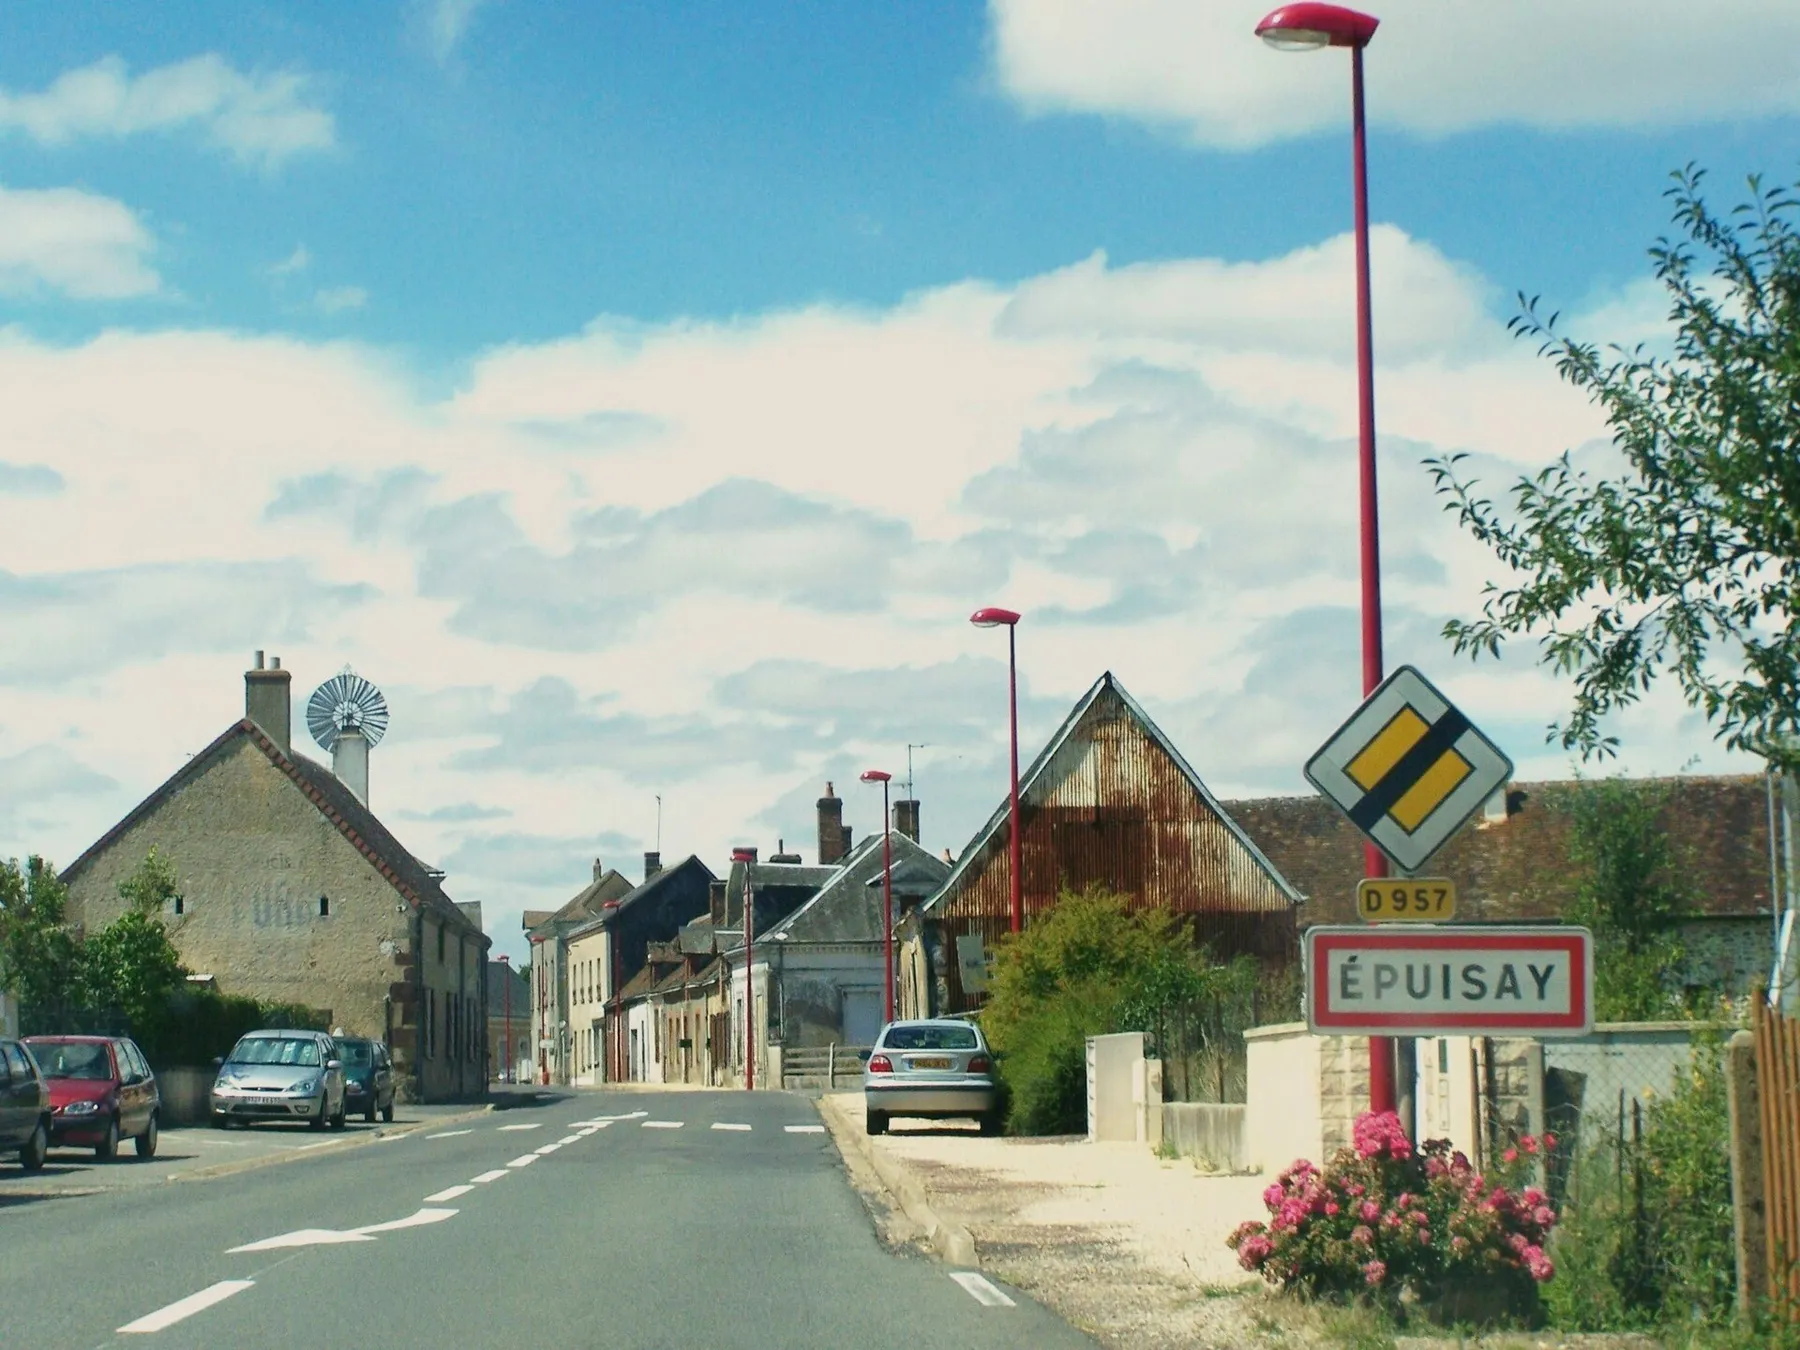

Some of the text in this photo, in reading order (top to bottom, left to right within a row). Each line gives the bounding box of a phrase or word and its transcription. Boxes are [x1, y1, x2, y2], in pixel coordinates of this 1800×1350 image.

[1366, 888, 1447, 912] D 957
[1340, 955, 1555, 1001] ÉPUISAY
